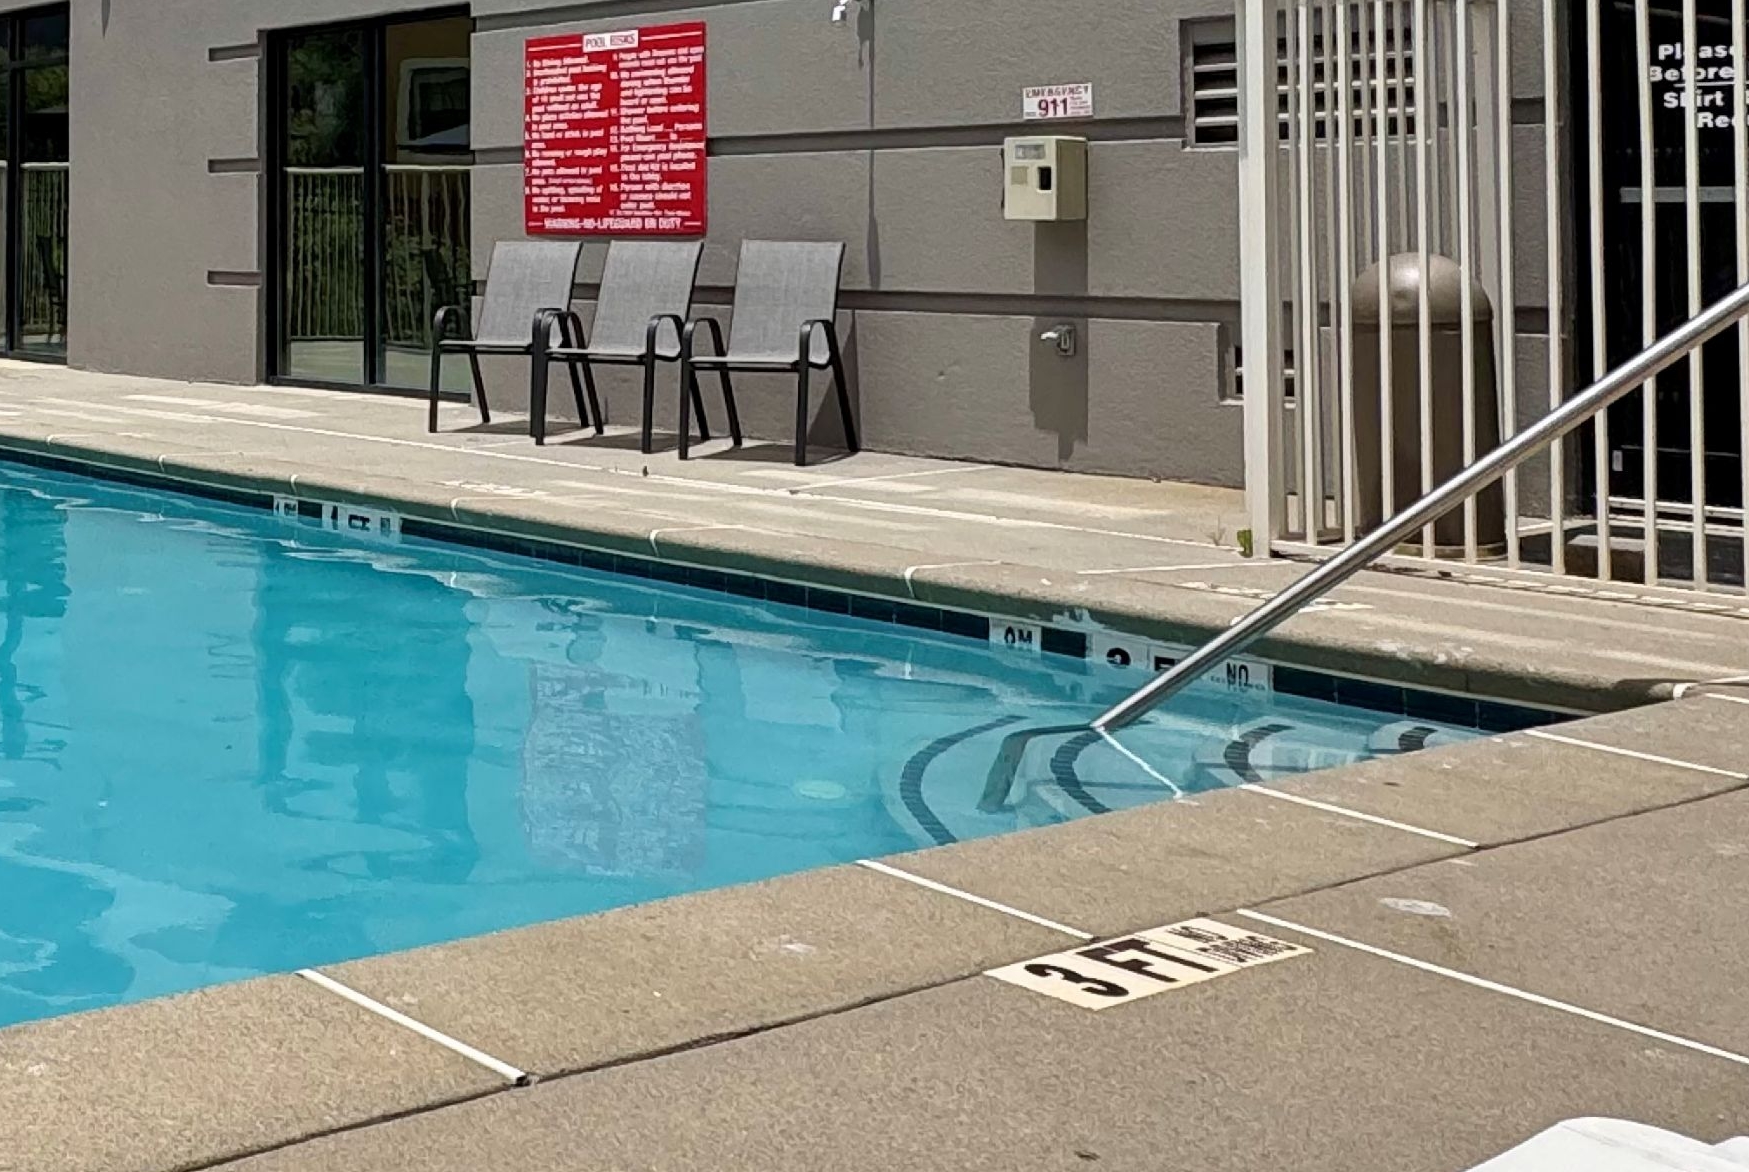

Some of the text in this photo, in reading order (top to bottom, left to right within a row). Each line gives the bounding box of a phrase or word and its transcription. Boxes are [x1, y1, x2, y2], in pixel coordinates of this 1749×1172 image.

[1658, 41, 1734, 61] Plas
[1038, 98, 1068, 117] 911
[1024, 938, 1220, 998] 3 FT
